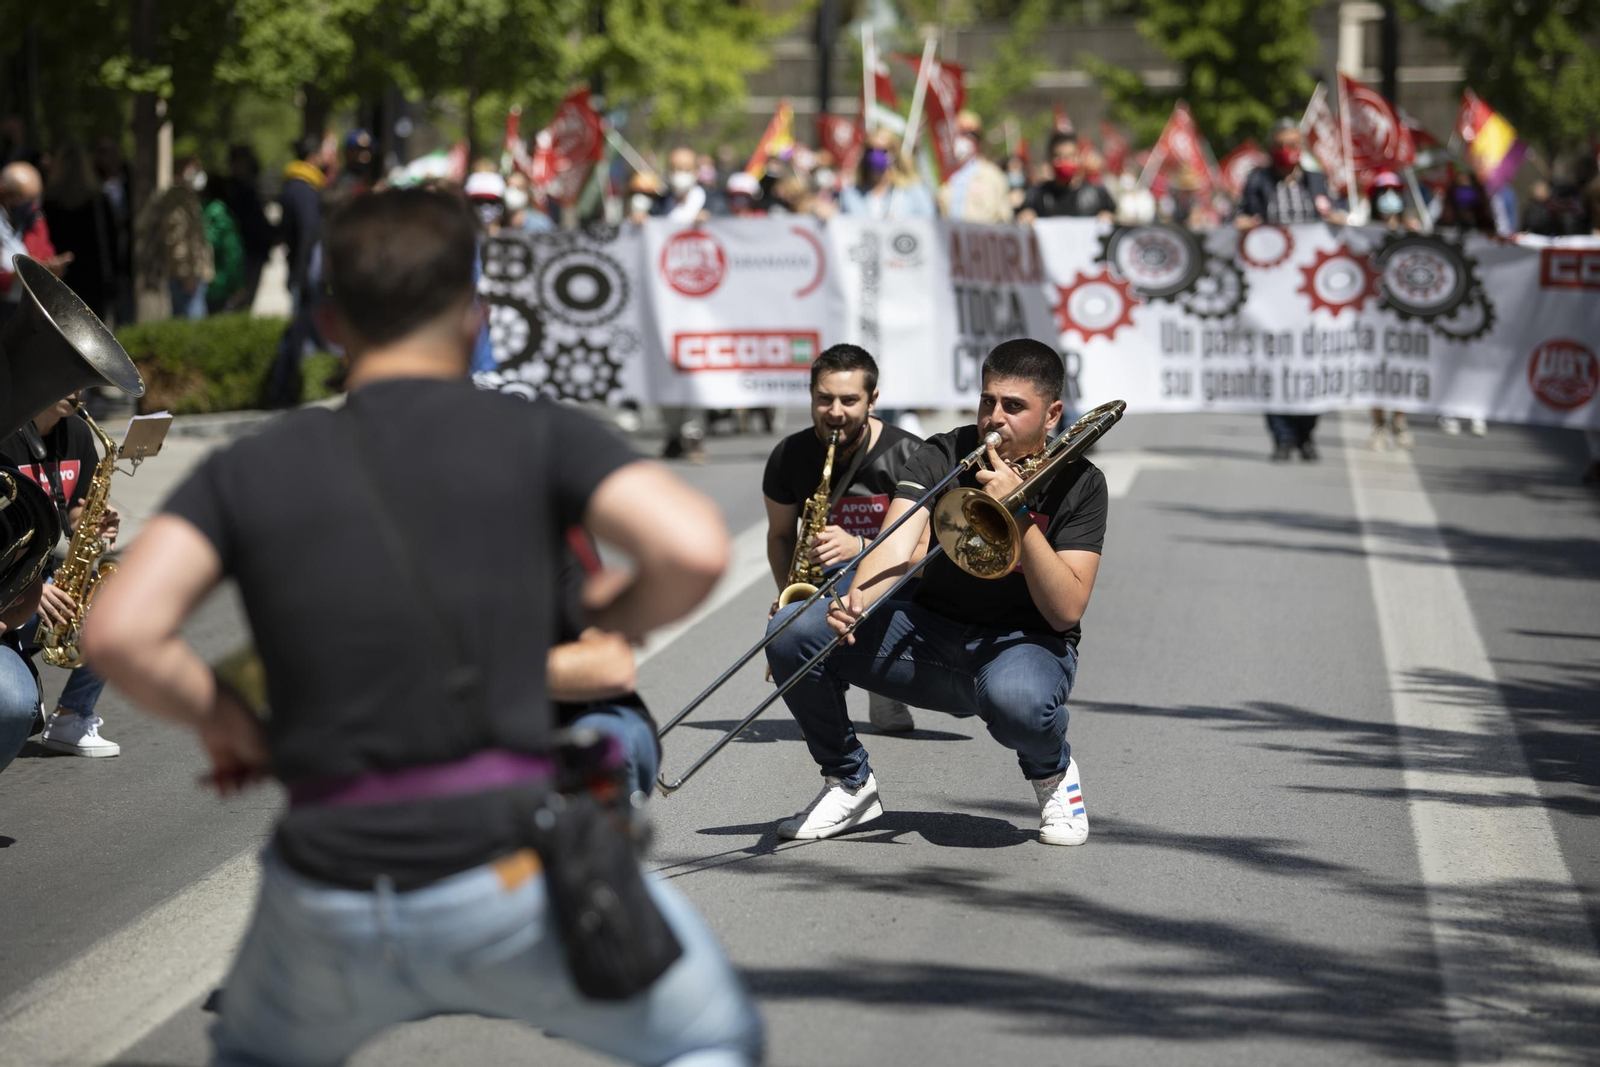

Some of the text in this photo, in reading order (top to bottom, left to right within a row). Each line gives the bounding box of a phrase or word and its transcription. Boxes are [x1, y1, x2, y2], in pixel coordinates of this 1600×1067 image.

[952, 284, 1029, 337] TOCA
[1160, 319, 1194, 356] Un
[1262, 329, 1293, 356] en
[1384, 328, 1430, 357] con
[1163, 361, 1430, 401] su gente trabajadora
[40, 470, 74, 482] AYO
[842, 503, 884, 512] APOYO
[844, 515, 871, 524] A LA
